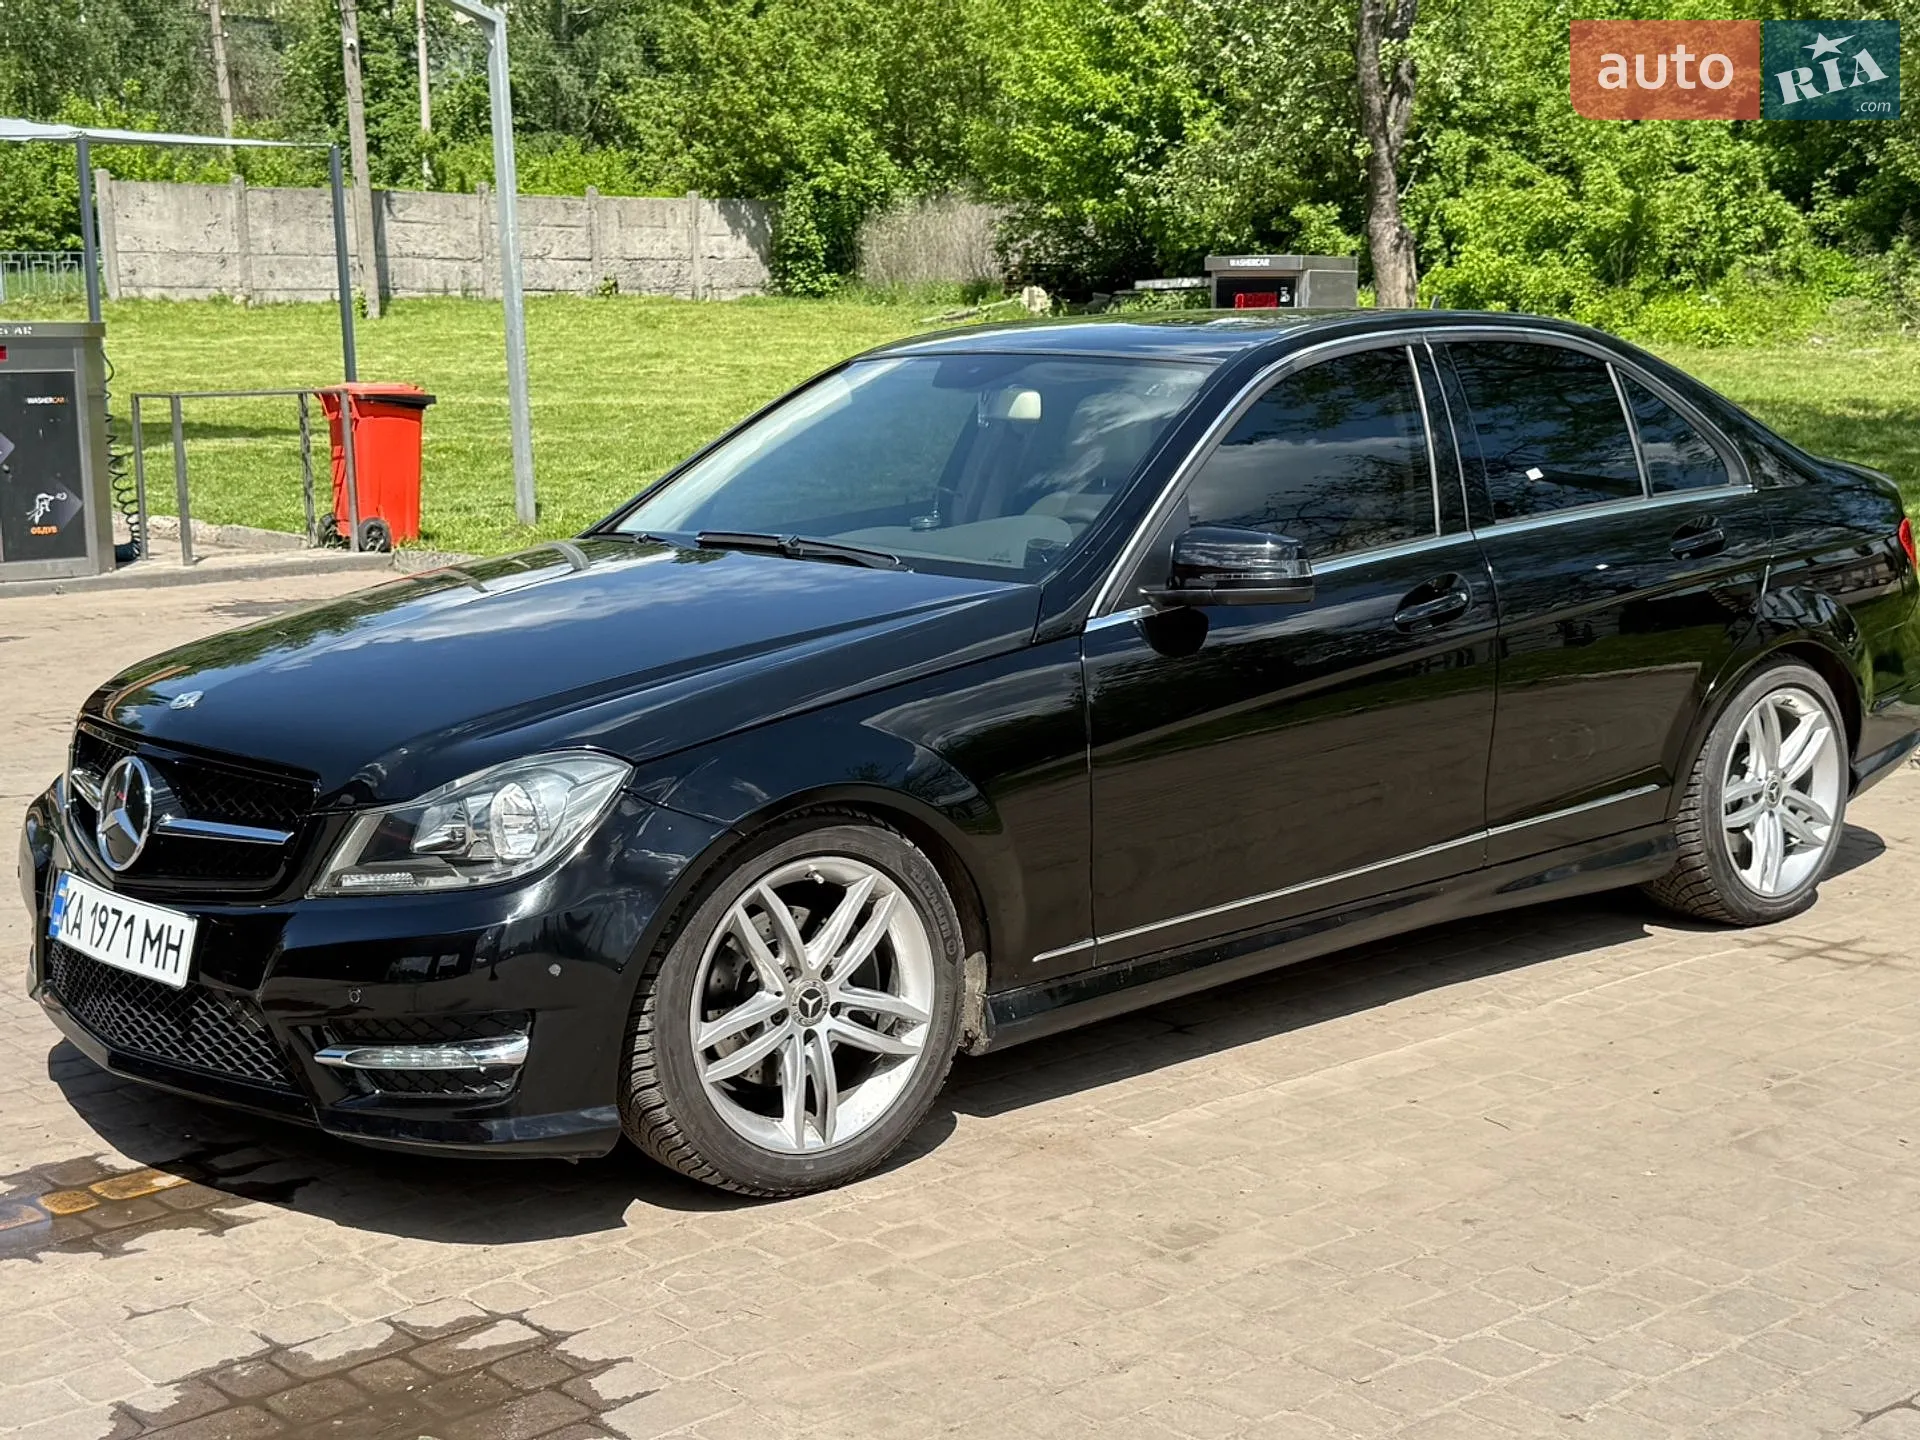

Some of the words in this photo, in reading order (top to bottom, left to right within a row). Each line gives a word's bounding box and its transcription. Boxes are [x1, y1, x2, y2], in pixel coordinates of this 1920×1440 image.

[1229, 258, 1270, 267] WASHERCAR
[61, 889, 83, 940] KA
[89, 901, 136, 959] 1971
[139, 918, 184, 974] MH
